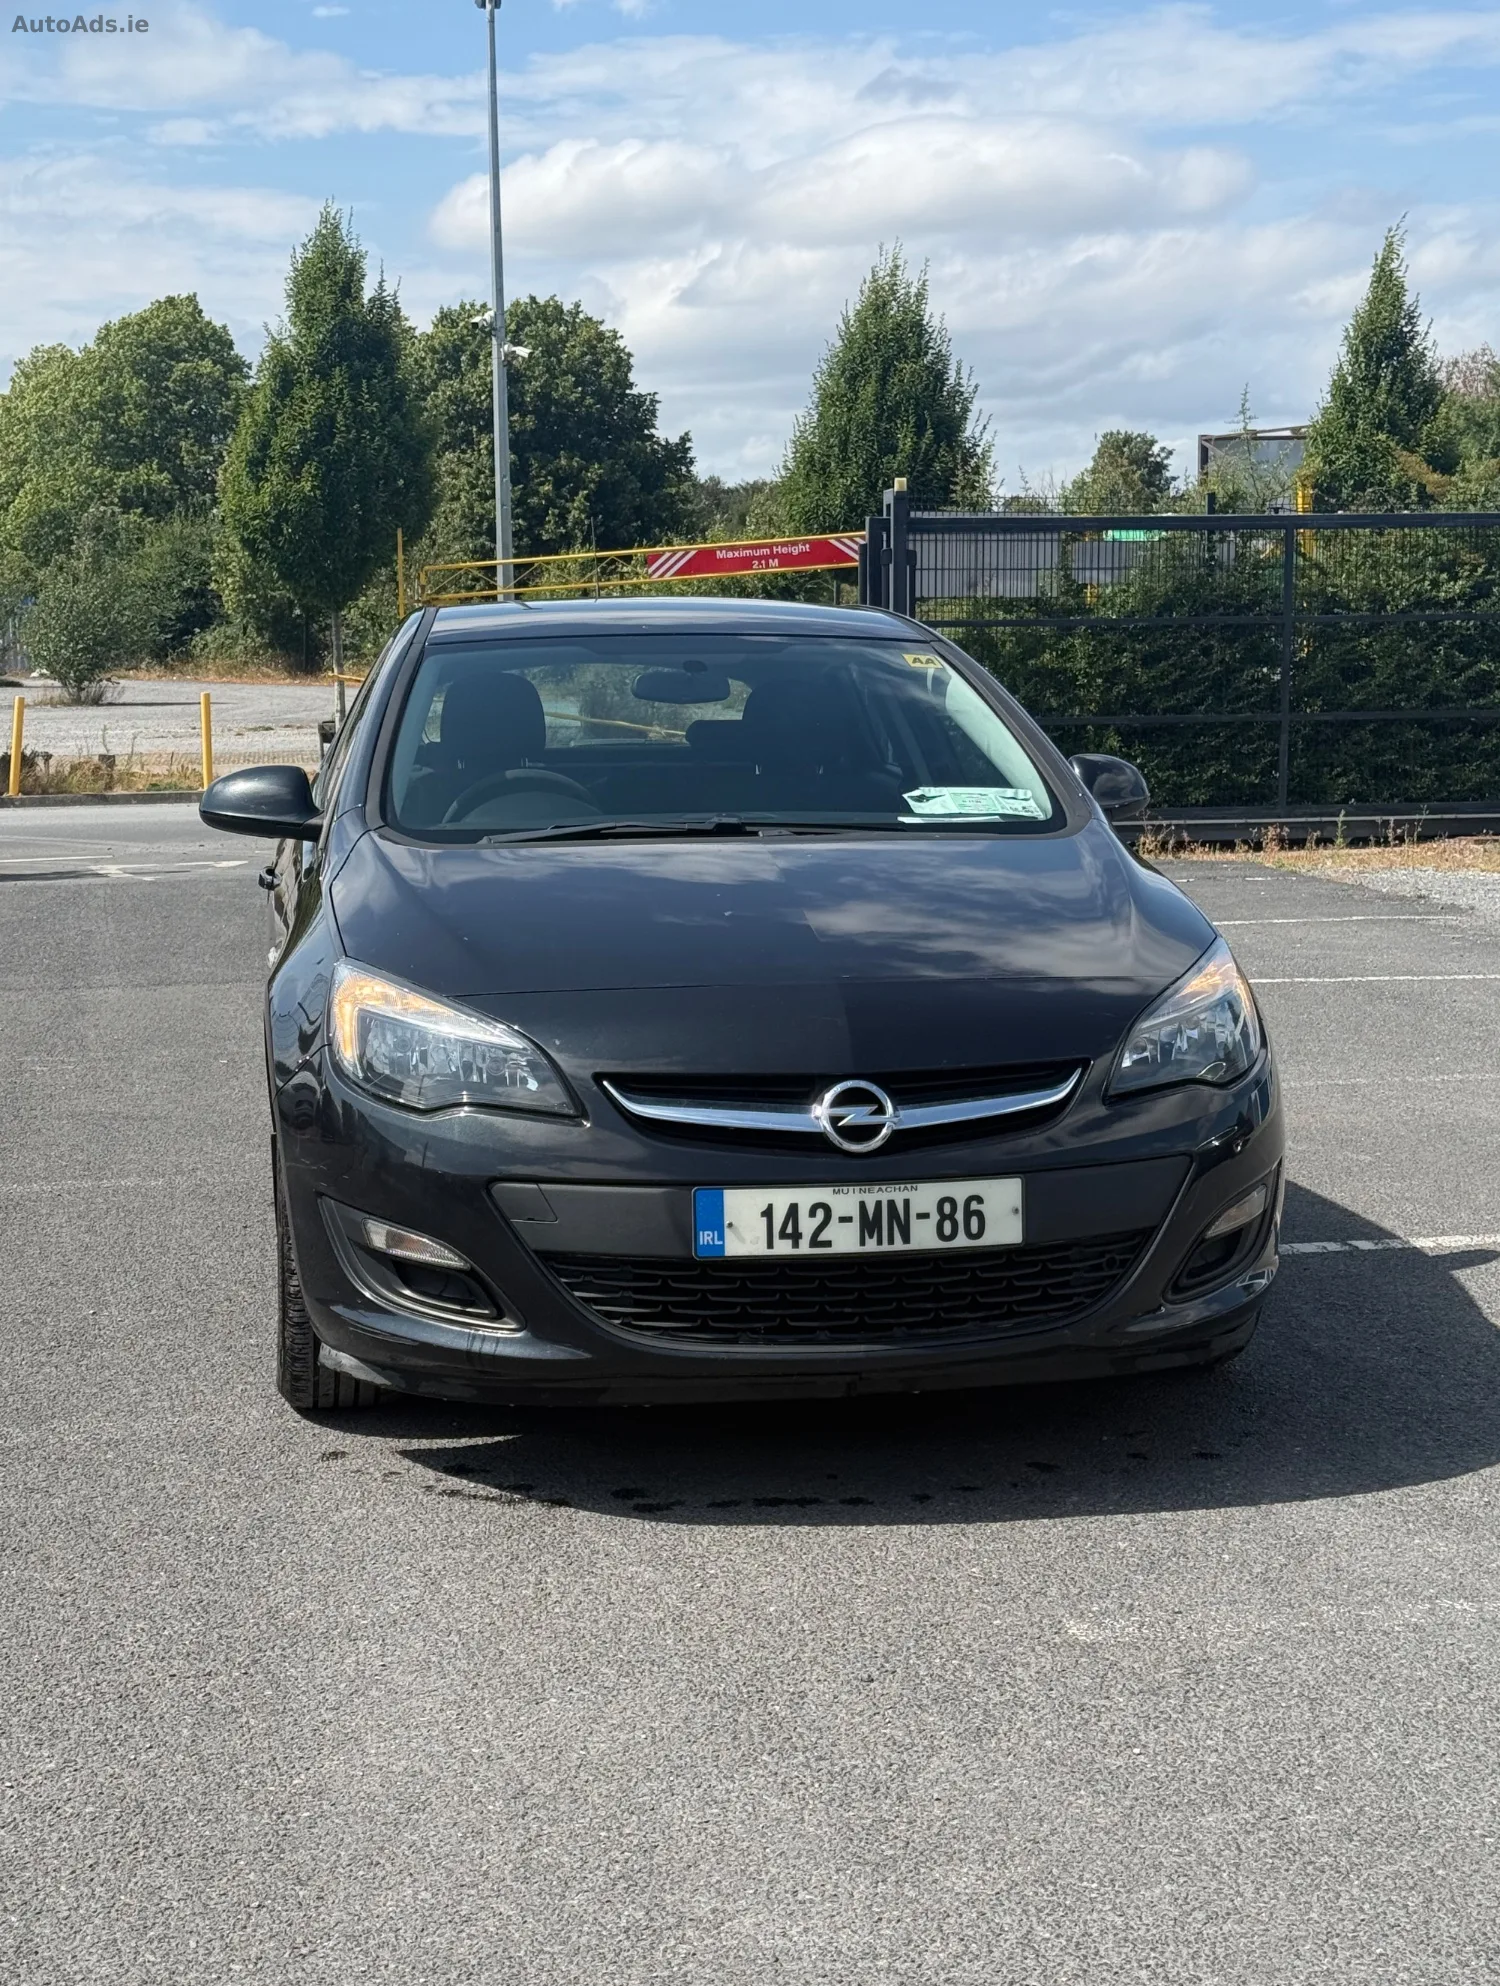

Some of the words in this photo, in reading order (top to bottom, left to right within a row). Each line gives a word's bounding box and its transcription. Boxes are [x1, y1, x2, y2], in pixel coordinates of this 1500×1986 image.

[716, 548, 770, 559] Maximum
[773, 543, 810, 555] Height
[752, 560, 766, 569] 2.1
[769, 559, 779, 568] M
[911, 656, 937, 666] AA
[760, 1194, 986, 1250] 142-MN-86
[699, 1230, 724, 1246] IRL
